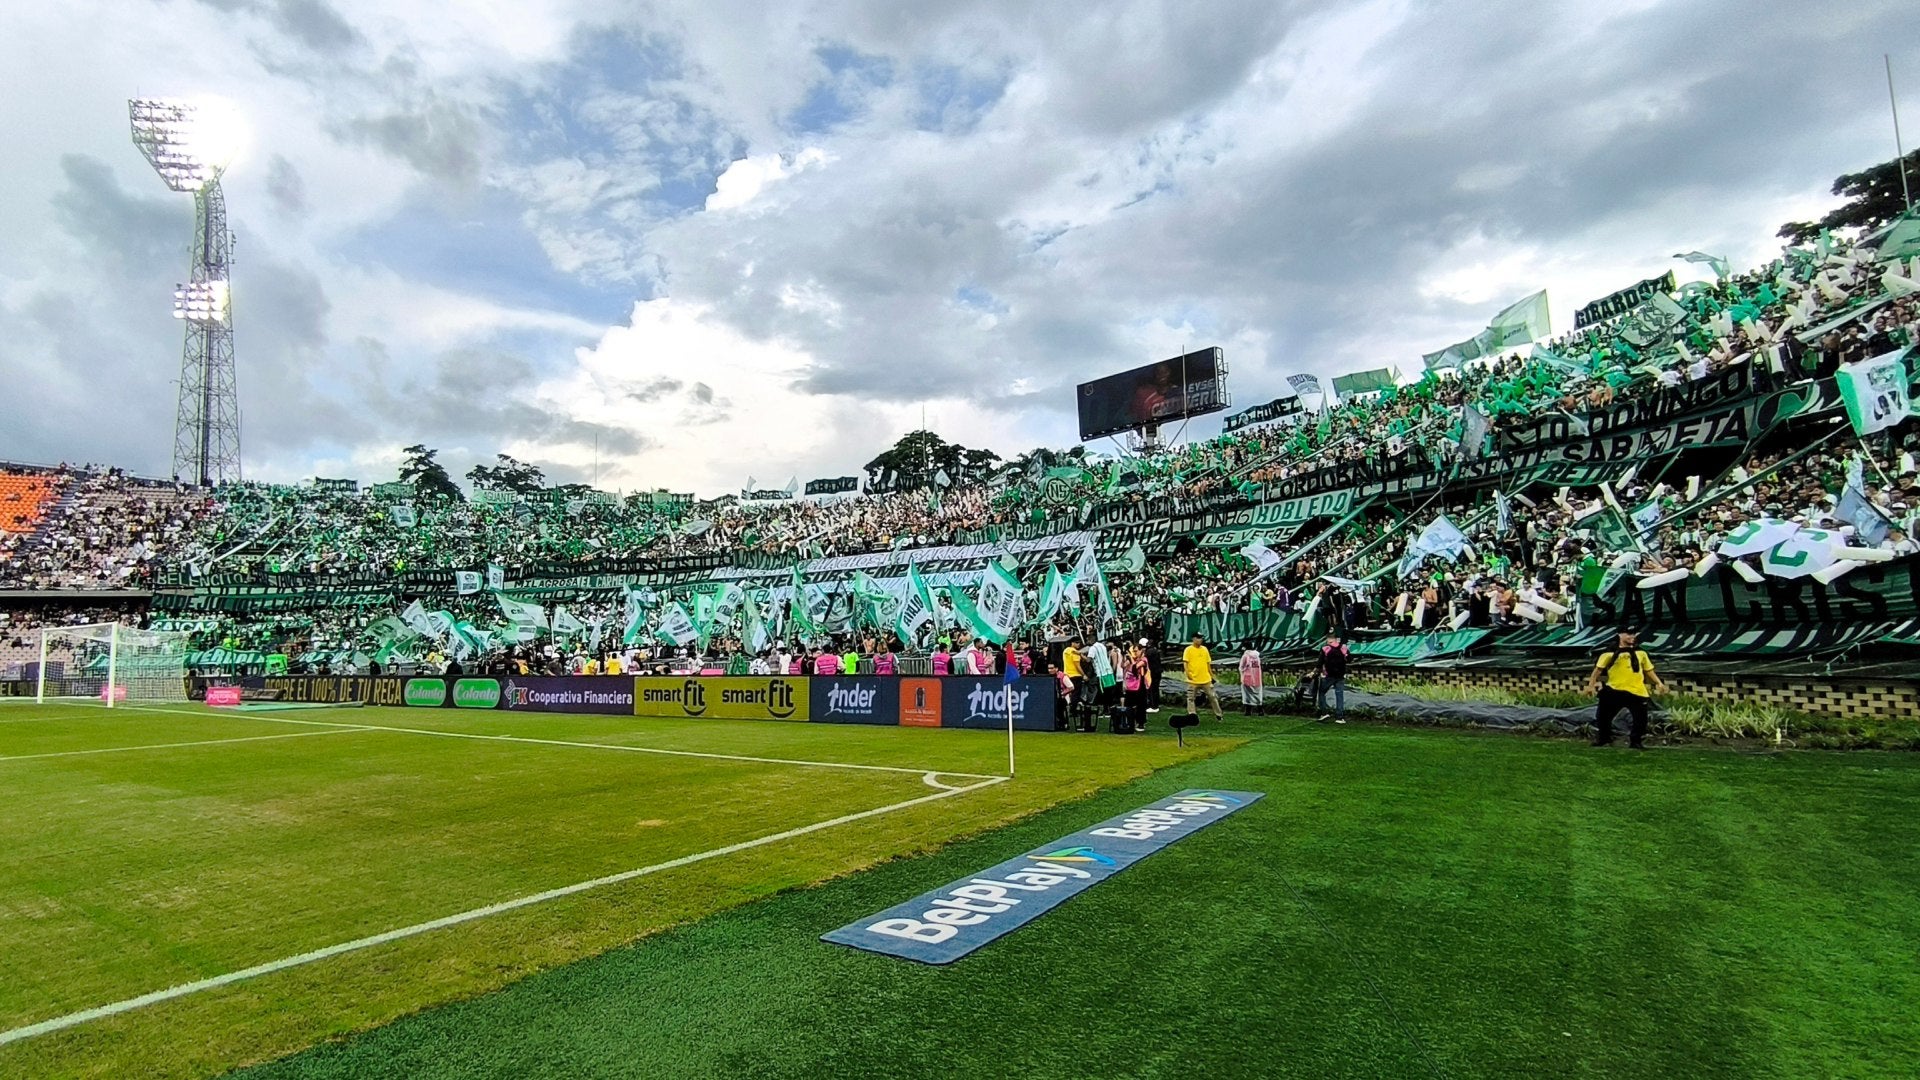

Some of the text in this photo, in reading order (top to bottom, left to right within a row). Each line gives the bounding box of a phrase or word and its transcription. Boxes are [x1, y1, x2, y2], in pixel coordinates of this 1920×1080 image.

[1576, 275, 1673, 327] GIRARDOTA
[1547, 462, 1632, 485] RETIR
[1256, 489, 1347, 526] ROBLEDO
[1016, 513, 1074, 540] POBLADO
[1205, 526, 1297, 545] LAS VEGAS
[157, 572, 244, 587] BELENCITO
[514, 578, 577, 588] MILAGROSA
[595, 574, 635, 588] CARMELO
[1166, 606, 1303, 644] BLANQUIZA
[297, 679, 307, 701] EL
[311, 678, 336, 702] 100%
[340, 678, 353, 702] DE
[357, 679, 372, 703] TU
[373, 679, 402, 705] RECA
[454, 683, 499, 701] Colanta
[528, 690, 582, 706] Cooperativa
[583, 690, 633, 705] Financiera
[643, 679, 706, 707] smart fit
[721, 679, 794, 708] smart fit
[826, 682, 877, 714] inder
[966, 682, 1029, 718] inder
[1089, 793, 1227, 841] BetPlay
[865, 861, 1092, 945] BetPlay
